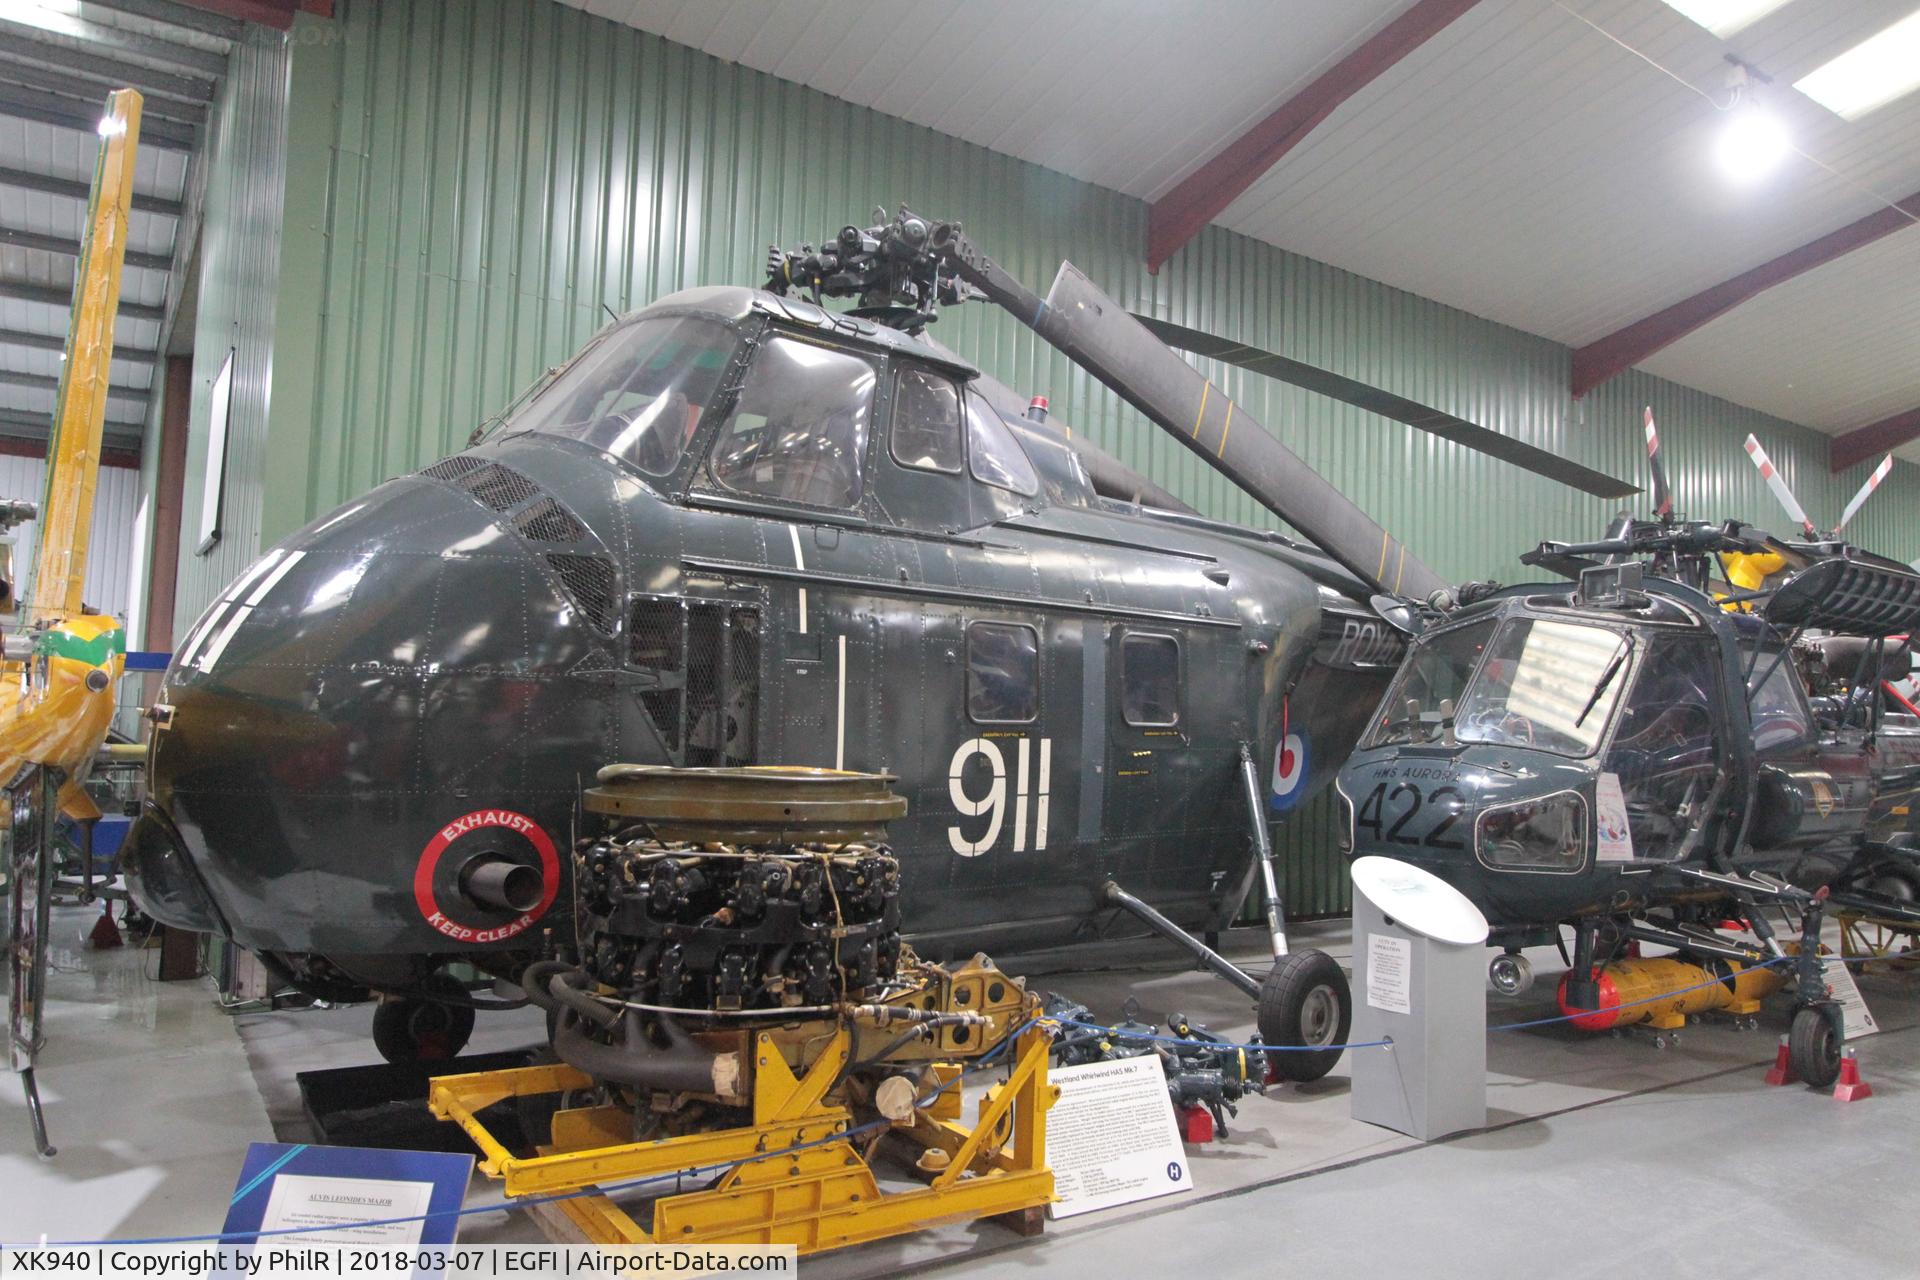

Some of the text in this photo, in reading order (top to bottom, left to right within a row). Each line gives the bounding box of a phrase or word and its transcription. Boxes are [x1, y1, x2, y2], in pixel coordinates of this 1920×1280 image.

[1372, 767, 1462, 785] HMS AURORA
[948, 738, 1051, 857] 911
[442, 812, 534, 842] EXHAUST
[1358, 782, 1466, 849] 422
[428, 912, 534, 942] KEEP CLEAR
[1051, 1075, 1080, 1085] Westland
[1080, 1069, 1110, 1081] Whirlwind
[308, 1193, 330, 1202] ALVIS
[367, 1196, 393, 1207] MAJOR
